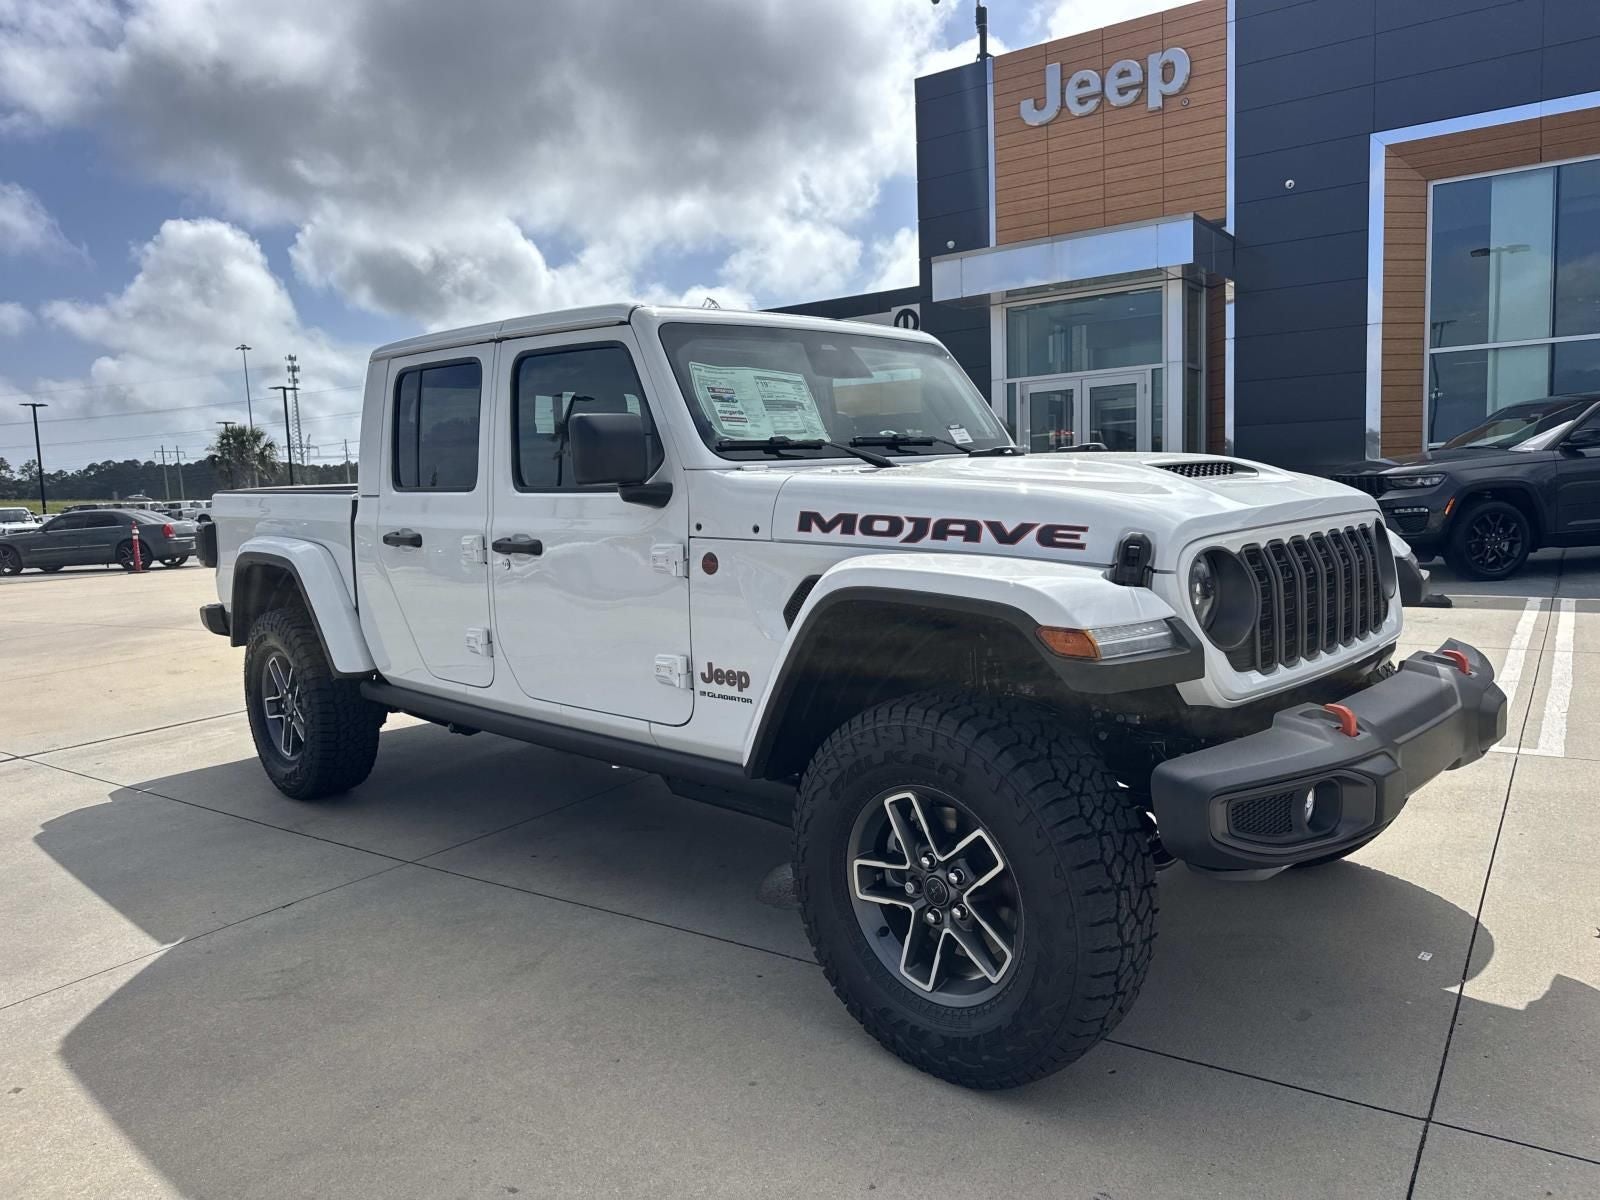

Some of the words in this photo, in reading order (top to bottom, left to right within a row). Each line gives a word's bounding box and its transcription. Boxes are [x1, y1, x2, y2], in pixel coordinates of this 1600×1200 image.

[1019, 47, 1191, 126] Jeep
[797, 510, 1089, 550] MOJAVE
[700, 662, 750, 692] Jeep
[708, 692, 752, 704] GLADIATOR
